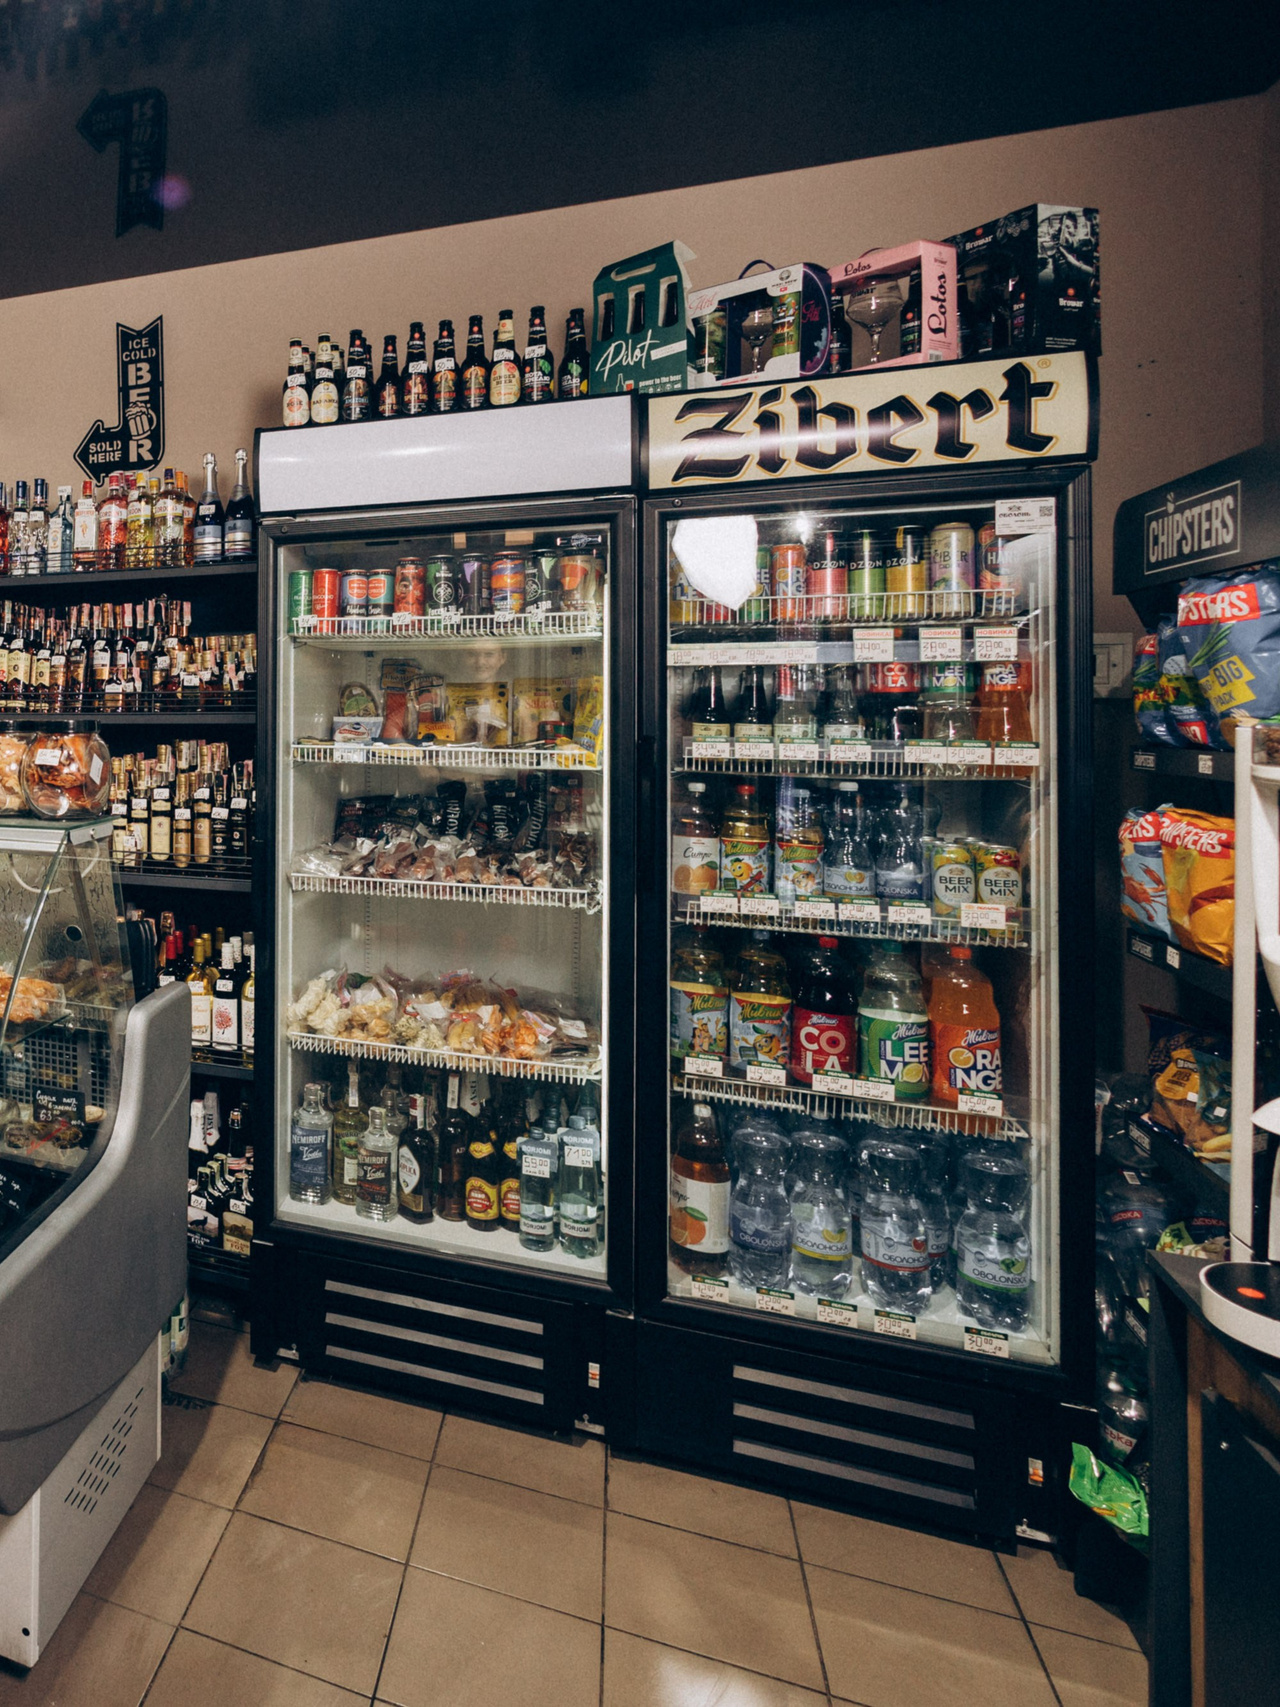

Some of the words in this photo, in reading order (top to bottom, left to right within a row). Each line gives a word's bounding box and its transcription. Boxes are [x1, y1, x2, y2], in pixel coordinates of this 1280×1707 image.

[844, 262, 872, 277] Lotos
[927, 271, 948, 338] Lotos
[128, 338, 149, 350] ICE
[122, 347, 157, 361] COLD
[671, 359, 1061, 485] Zibert
[89, 441, 121, 453] SOLD
[89, 451, 121, 464] HERE
[883, 664, 907, 676] CO
[935, 665, 964, 676] LEE
[887, 677, 908, 687] LA
[939, 875, 973, 885] BEER
[984, 878, 1018, 888] BEER
[944, 884, 969, 894] MIX
[990, 887, 1016, 897] MIX
[799, 1026, 846, 1054] CO
[886, 1040, 929, 1062] LEE
[806, 1051, 842, 1074] LA
